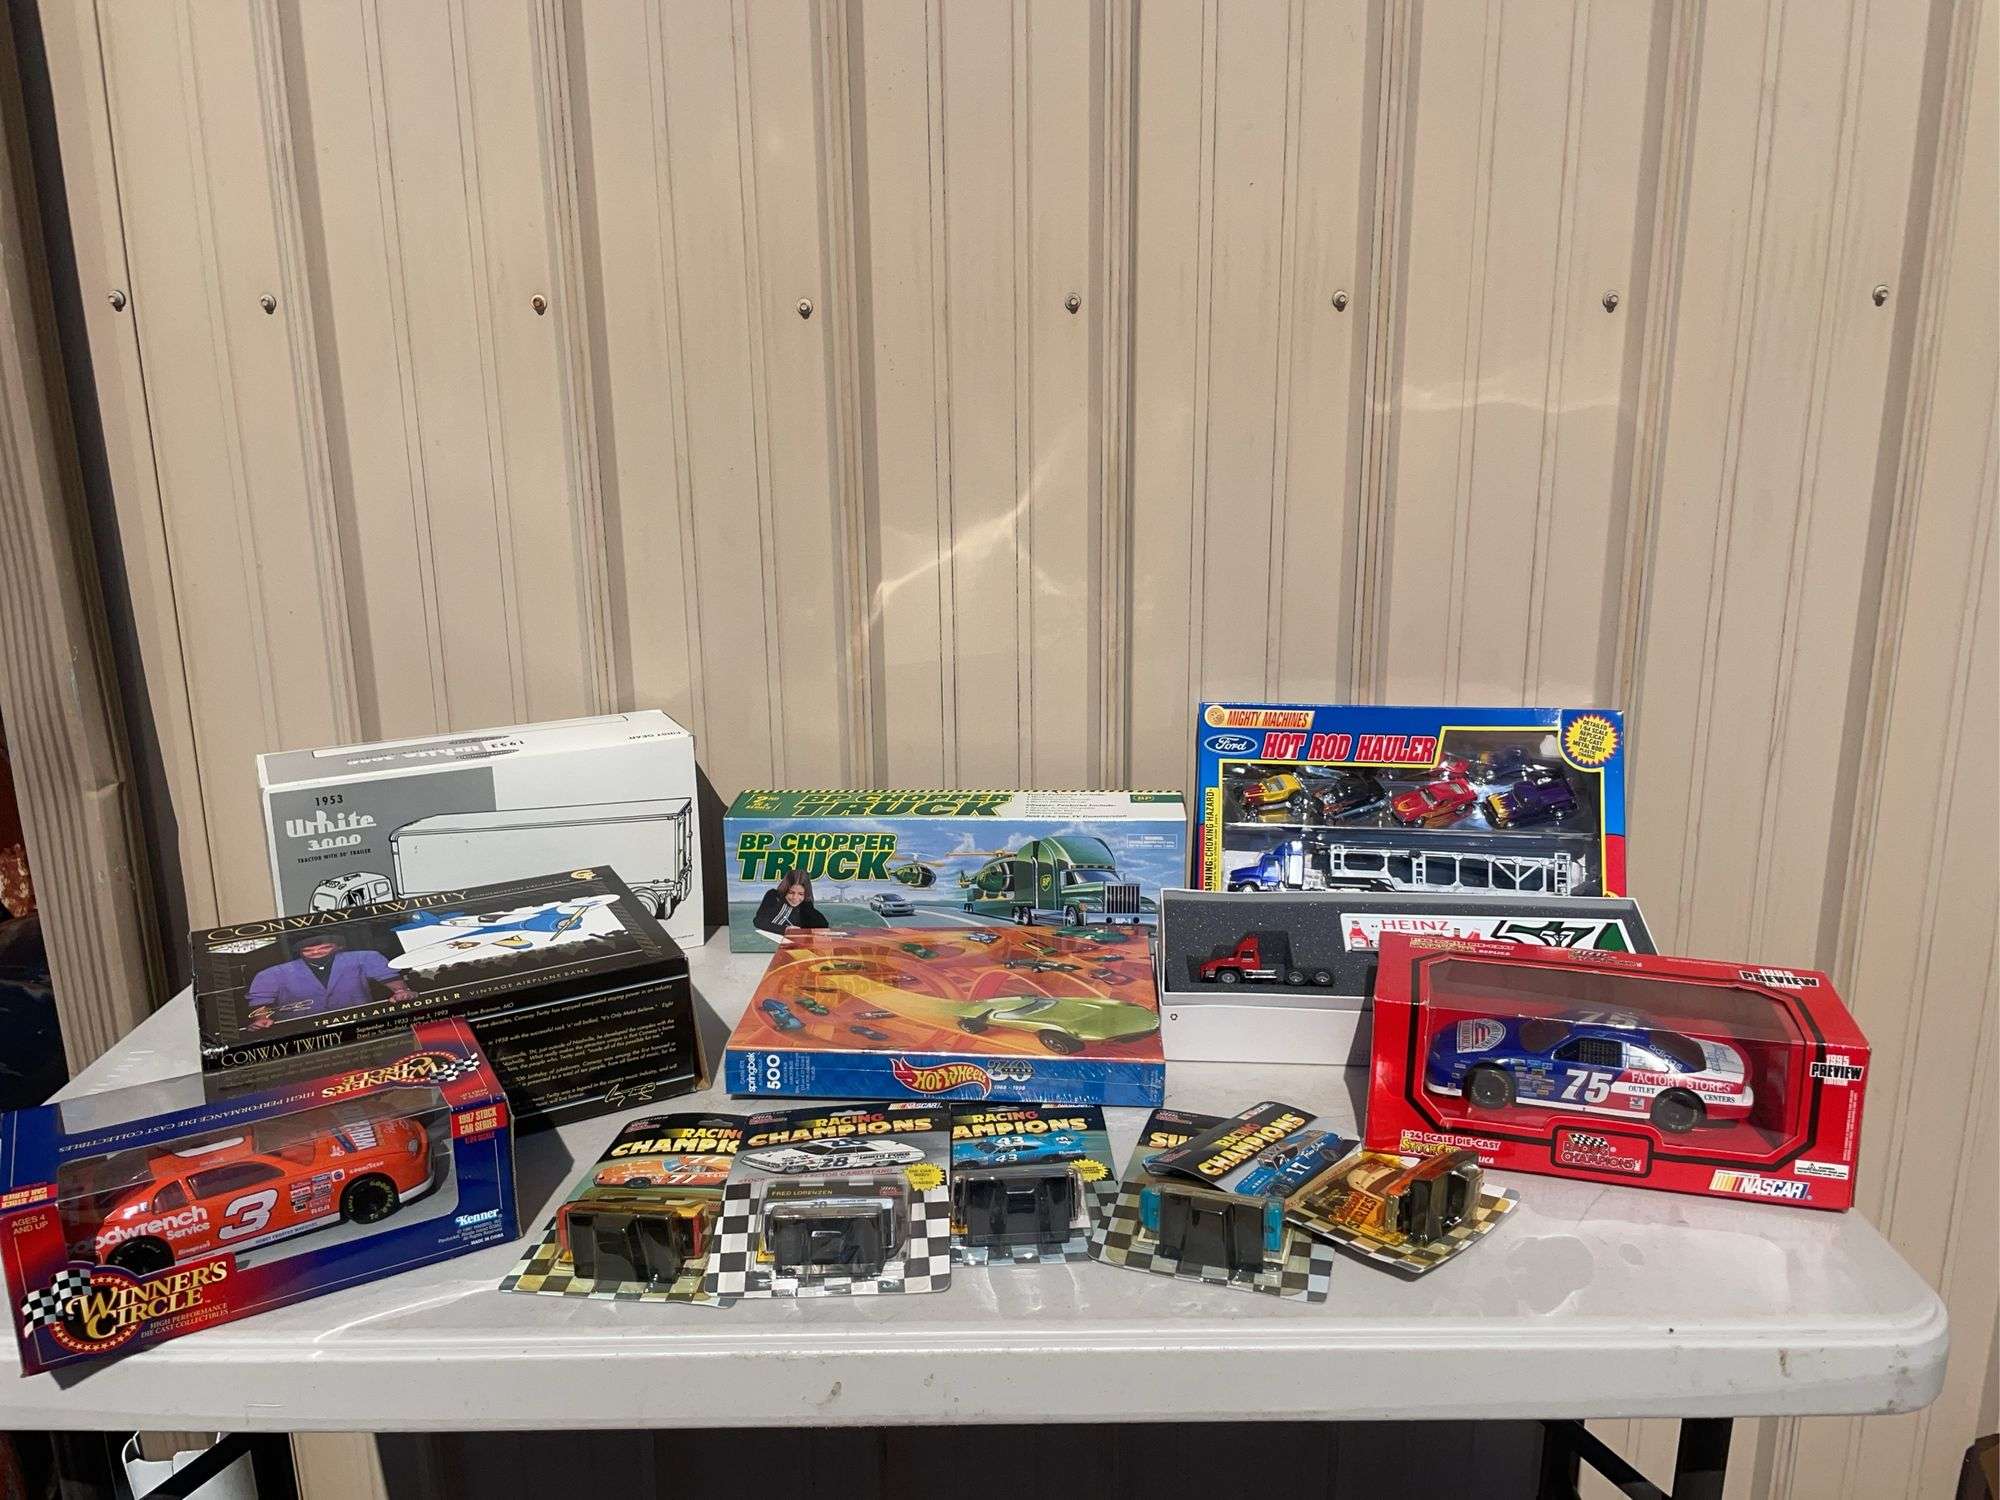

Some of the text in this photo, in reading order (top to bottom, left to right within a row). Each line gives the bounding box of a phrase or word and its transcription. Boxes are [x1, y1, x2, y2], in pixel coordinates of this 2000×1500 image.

[1227, 711, 1309, 727] MIGHTY MACHINES
[1215, 732, 1437, 764] Ford HOT ROD HAULER
[315, 794, 343, 806] 1953
[792, 801, 1001, 817] TRUCK
[286, 810, 376, 837] White
[308, 834, 361, 850] 3000
[739, 832, 897, 851] BP CHOPPER
[1206, 823, 1214, 856] CHOKING
[736, 849, 894, 882] TRUCK
[1205, 857, 1213, 891] ARNING:
[207, 891, 467, 941] CONWAY TWITTY
[1381, 919, 1449, 931] HEINZ
[1741, 972, 1818, 987] PREVIEW
[314, 1011, 367, 1027] TRAVEL
[372, 1006, 395, 1016] AIR
[402, 996, 448, 1009] MODEL
[469, 983, 512, 995] VINTAGE
[516, 974, 561, 986] AIRPLANE
[564, 968, 590, 977] BANK
[221, 1041, 288, 1067] CONWAY
[294, 1032, 343, 1056] TWITTY
[767, 1054, 781, 1090] 500
[1632, 1072, 1734, 1093] FACTORY STORES
[1811, 1063, 1863, 1081] PREVIEW
[1561, 1069, 1613, 1103] 75
[1628, 1085, 1736, 1104] OUTLET CENTERS
[197, 1094, 282, 1122] PERFORMANCE
[475, 1107, 497, 1120] STOCK
[972, 1110, 1039, 1123] RACING
[145, 1122, 175, 1136] CAST
[177, 1117, 196, 1128] DIE
[815, 1113, 885, 1128] RACING
[952, 1118, 1088, 1140] AMPIONS
[58, 1130, 143, 1153] COLLECTIBLES
[748, 1118, 932, 1147] CHAMPIONS
[1214, 1123, 1262, 1148] RACING
[1401, 1129, 1501, 1150] 1:24 SCALE DIE-CAST
[611, 1139, 739, 1157] CHAMPI
[1198, 1113, 1306, 1176] CHAMPIONS
[820, 1157, 849, 1168] 28
[995, 1154, 1018, 1163] 43
[1286, 1162, 1311, 1176] 17
[1478, 1156, 1494, 1164] LICA
[1561, 1151, 1634, 1171] CHAMPIONS
[1740, 1178, 1804, 1199] NASCAR
[12, 1217, 38, 1228] AGES
[218, 1188, 279, 1241] 3
[456, 1209, 499, 1226] Kenner
[13, 1221, 49, 1235] AND UP
[95, 1206, 208, 1249] odwrench
[167, 1222, 210, 1240] Service
[66, 1261, 228, 1323] WINNER'S
[87, 1288, 203, 1339] CIRCLE
[141, 1310, 229, 1338] DIE CAST COLLECTIBLES
[150, 1303, 228, 1329] HIGH PERFORMANCE
